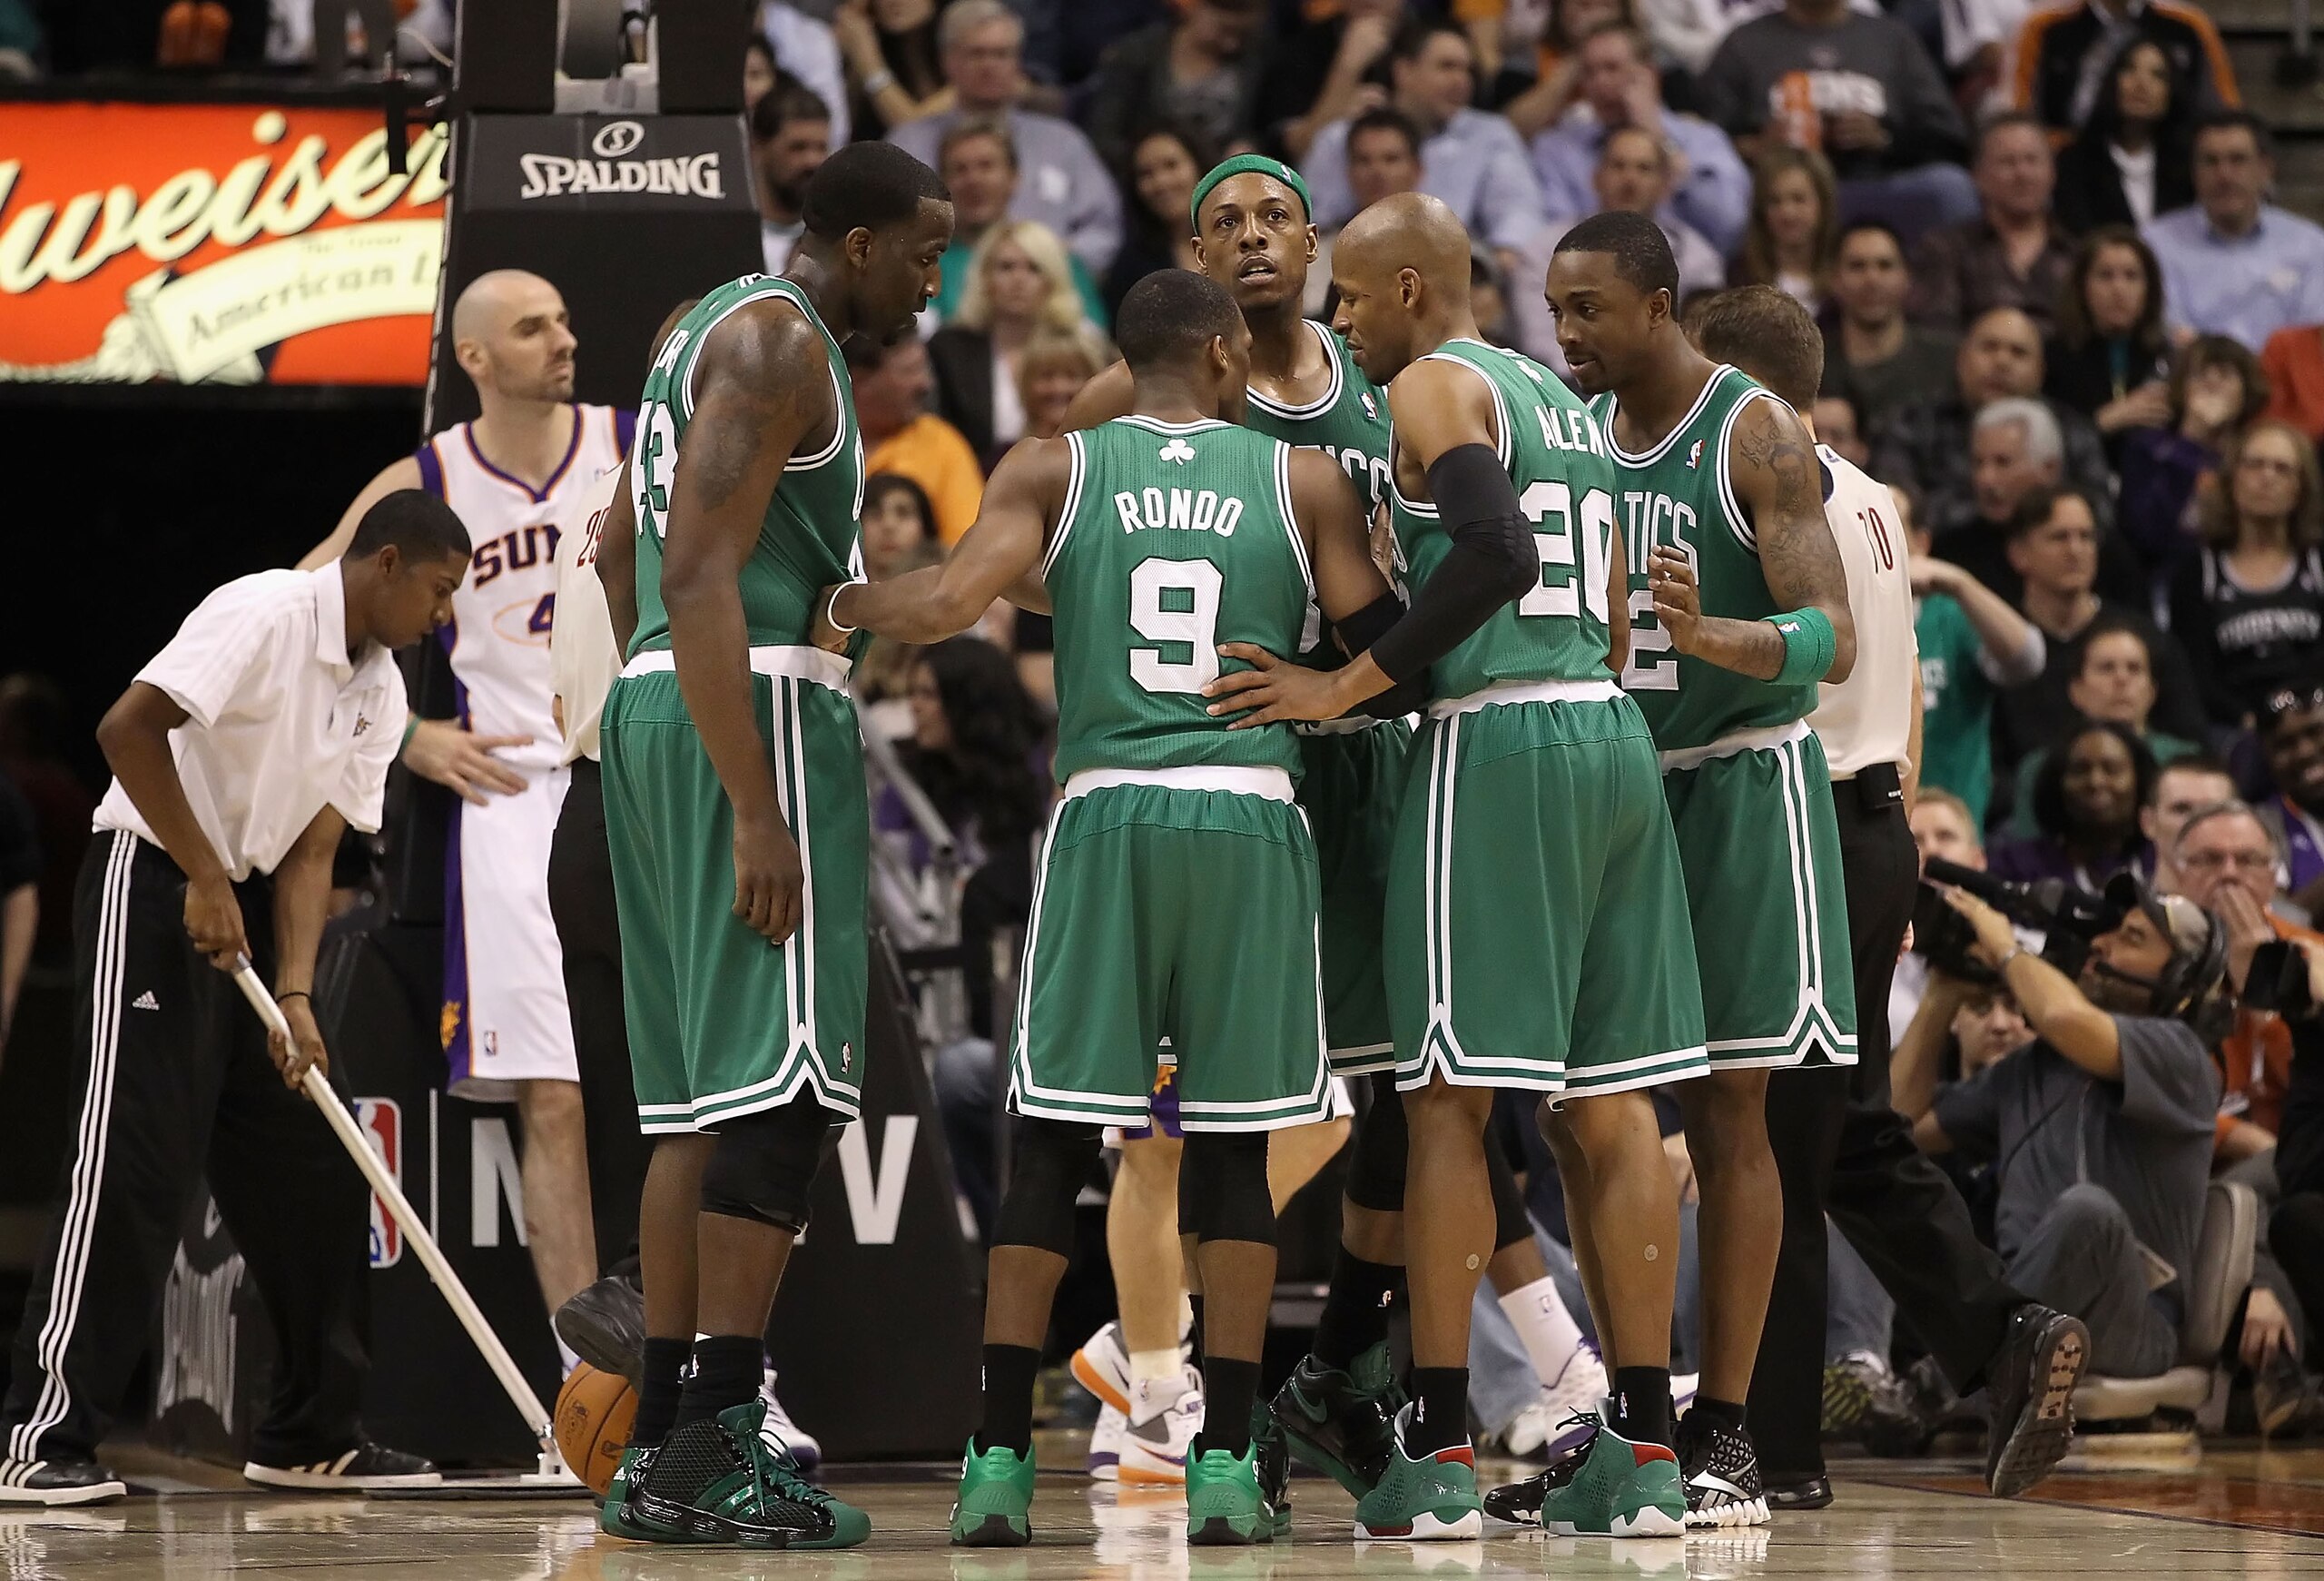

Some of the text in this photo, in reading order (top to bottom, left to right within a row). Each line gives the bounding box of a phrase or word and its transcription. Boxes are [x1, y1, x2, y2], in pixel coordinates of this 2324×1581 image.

[0, 111, 451, 293] weiser
[520, 152, 726, 200] SPALDING
[186, 262, 395, 354] American
[1114, 486, 1245, 538] RONDO
[1514, 479, 1613, 627] 20
[1129, 557, 1225, 694] 9
